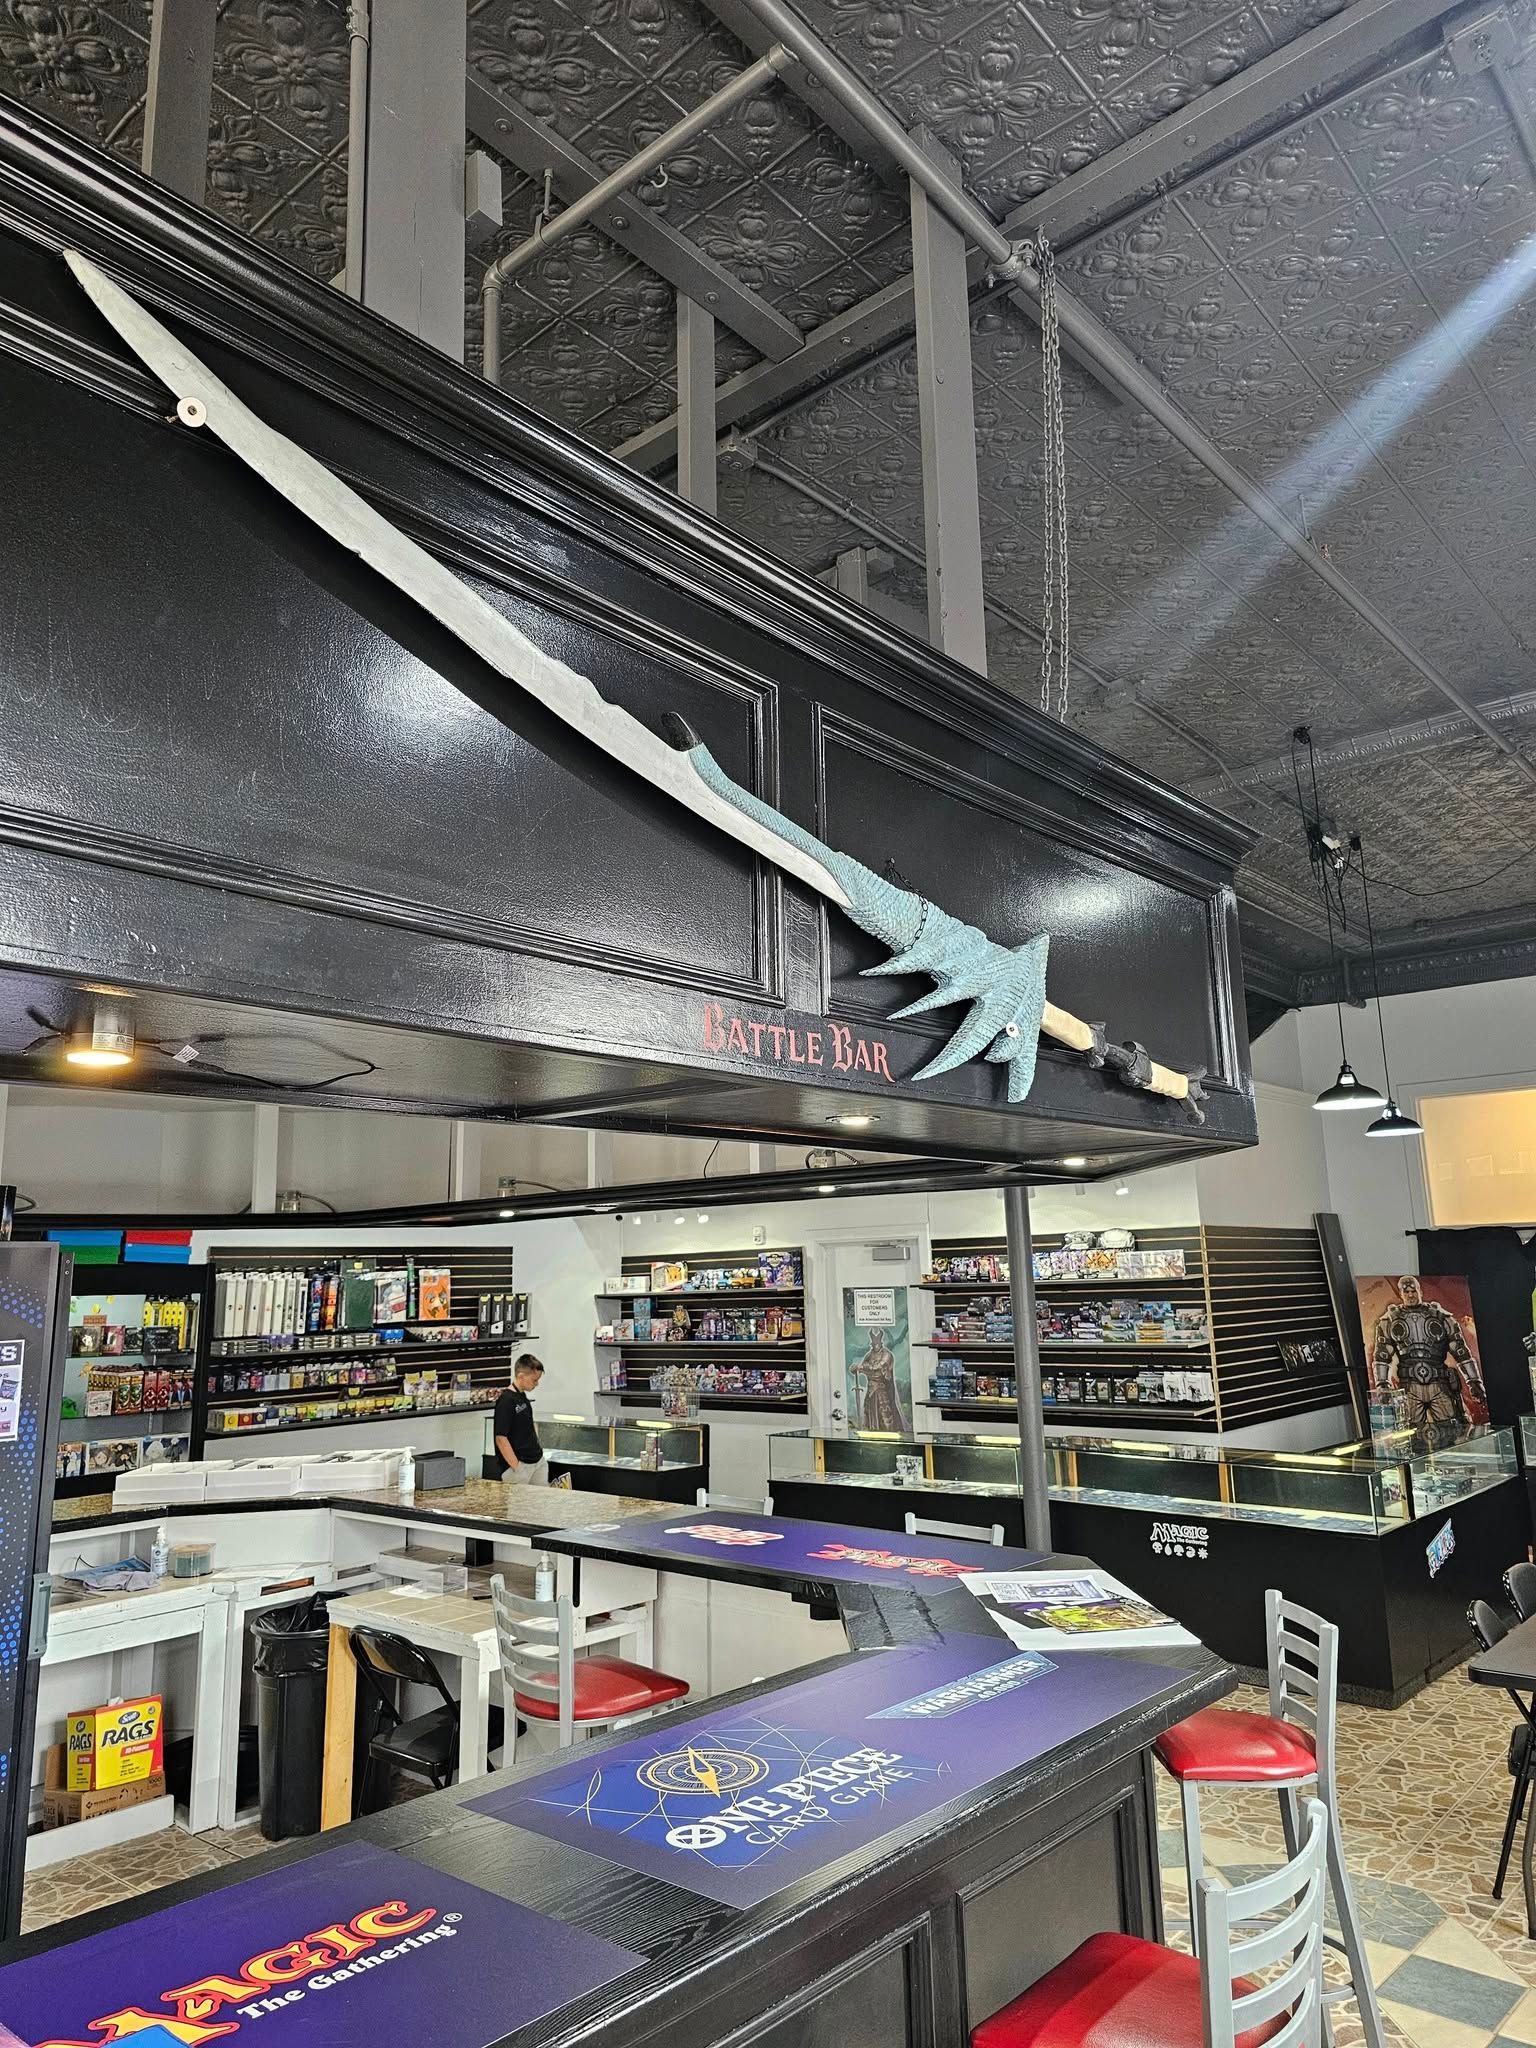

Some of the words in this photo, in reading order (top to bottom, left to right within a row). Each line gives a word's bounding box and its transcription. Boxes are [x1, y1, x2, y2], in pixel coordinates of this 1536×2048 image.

[703, 1002, 824, 1067] BATTLE
[827, 1023, 896, 1083] BAR
[1150, 1522, 1209, 1543] MAGIC
[901, 1659, 1045, 1715] WARHAMMER
[69, 1732, 92, 1751] RAGS
[101, 1720, 155, 1748] RAGS
[665, 1796, 793, 1850] ONE
[767, 1747, 903, 1802] PIECE
[745, 1806, 829, 1845] CARD
[830, 1767, 913, 1805] GAME
[237, 1989, 306, 2019] The
